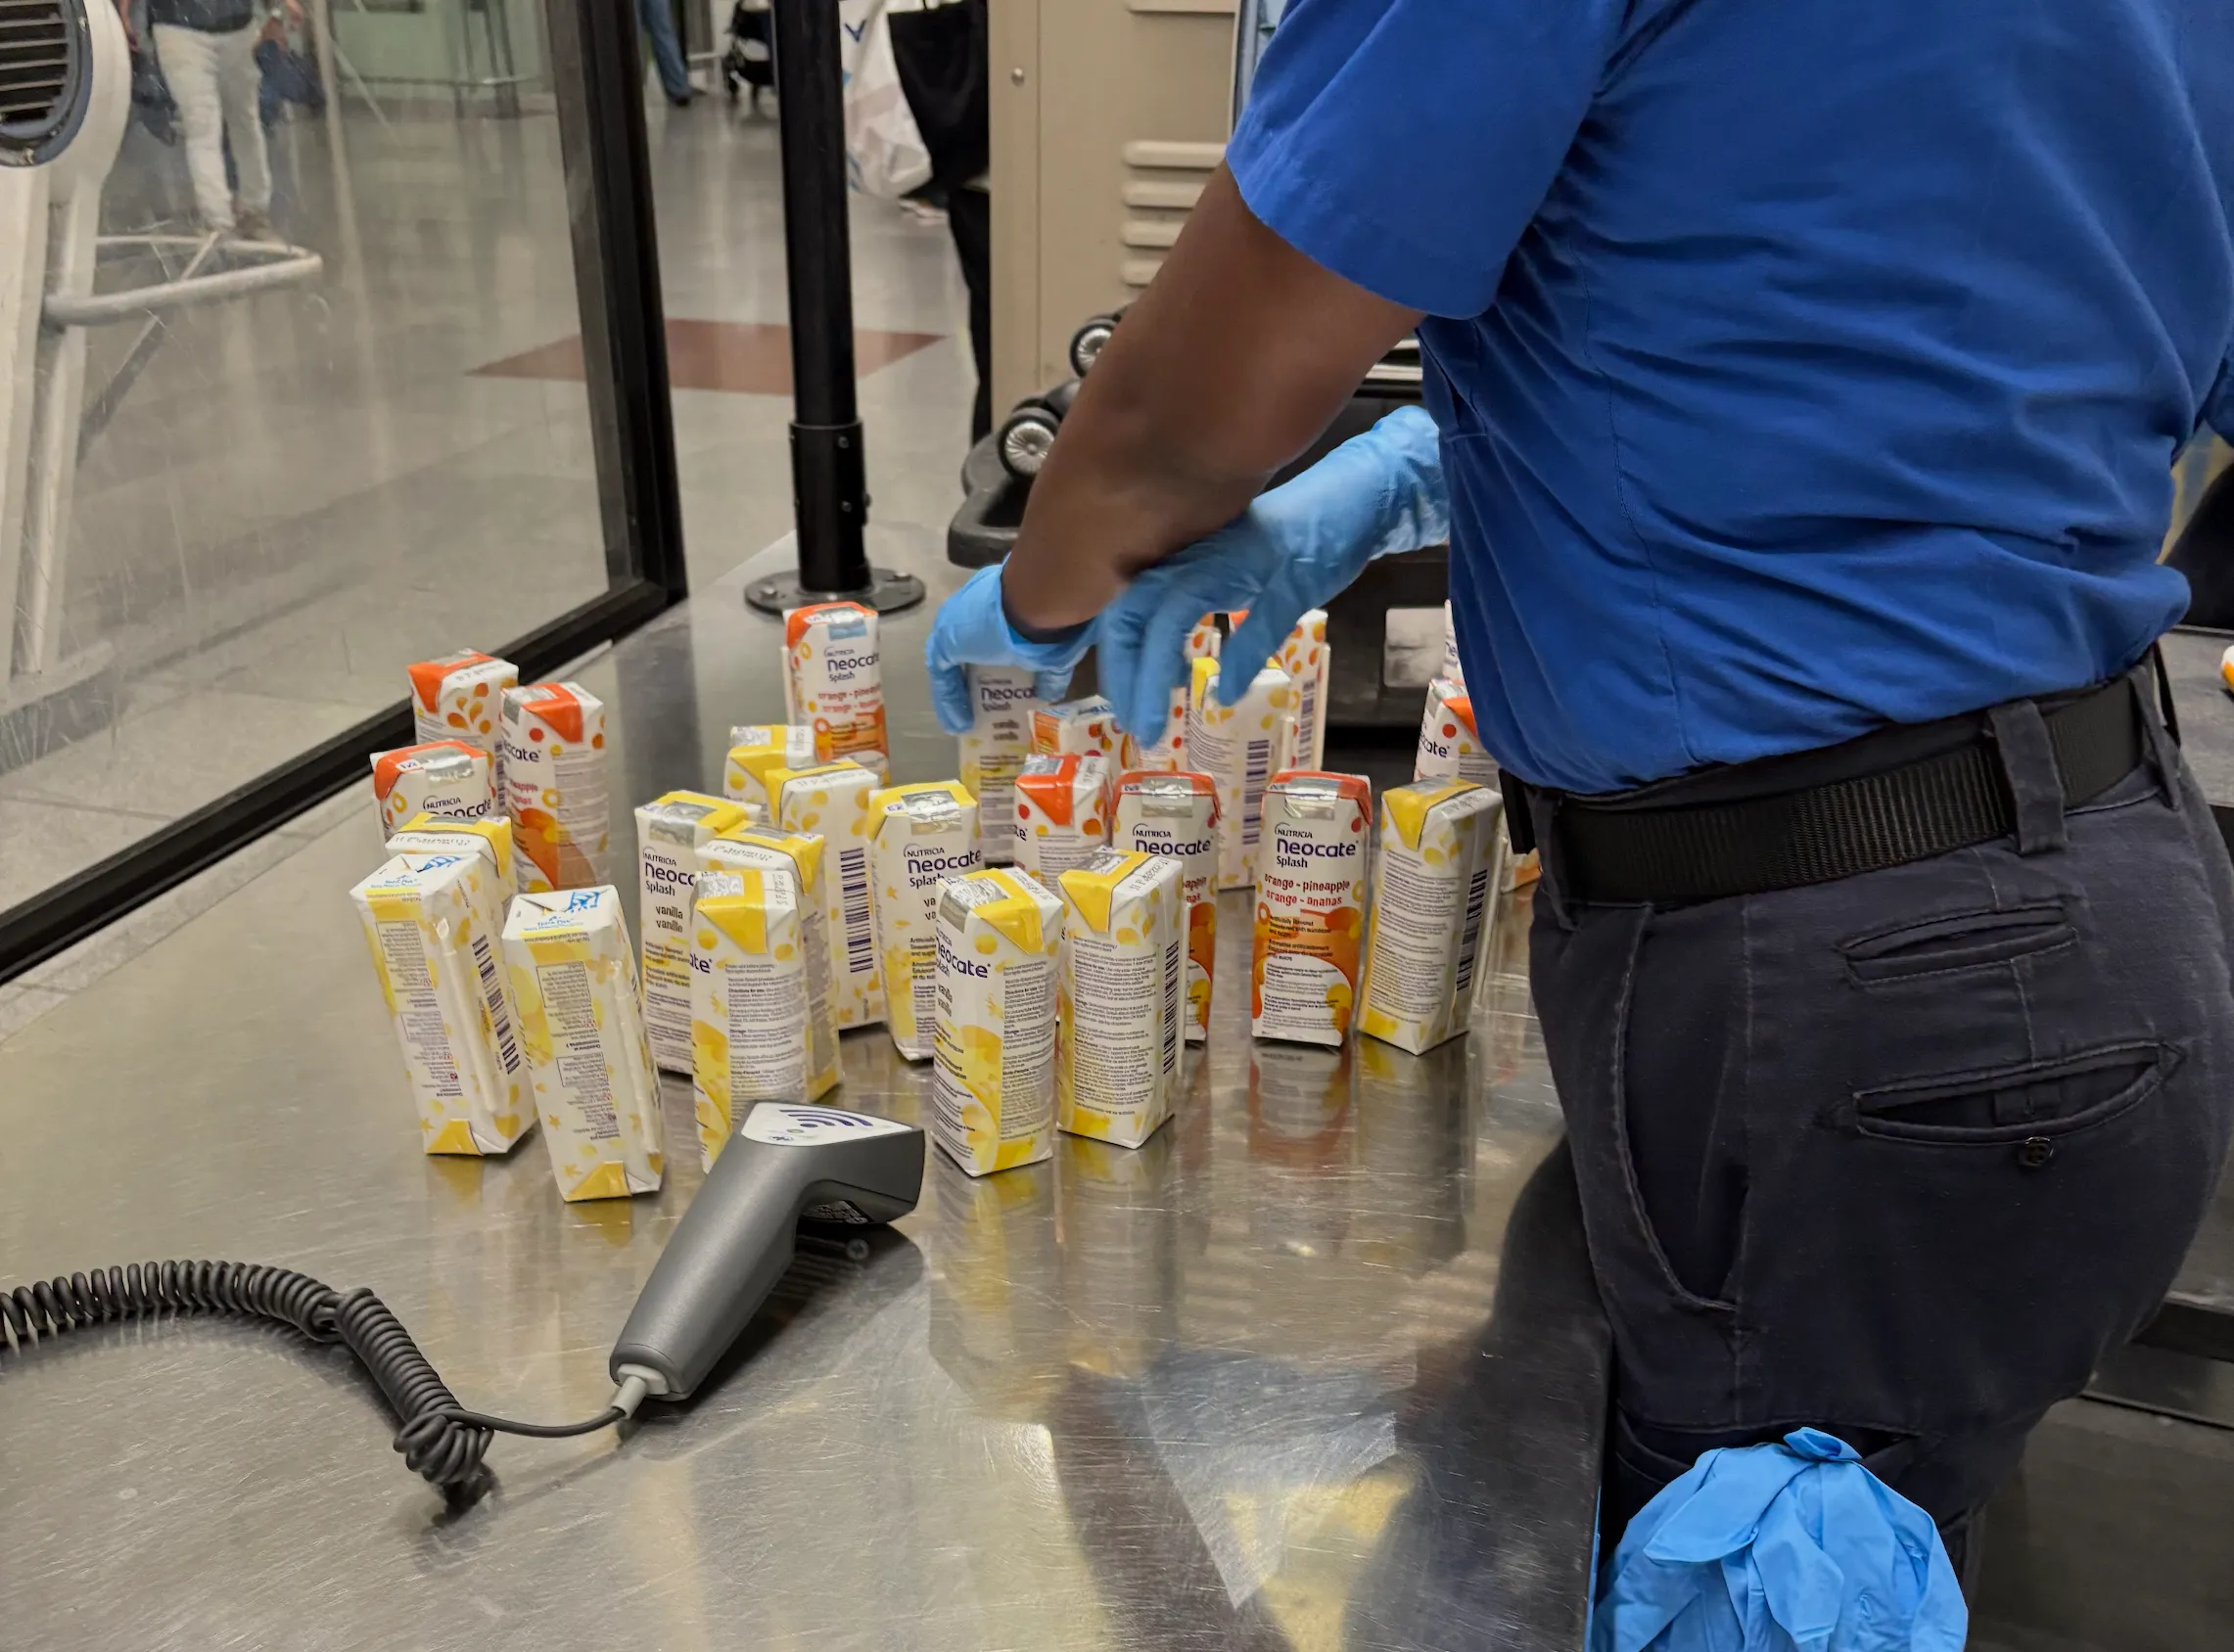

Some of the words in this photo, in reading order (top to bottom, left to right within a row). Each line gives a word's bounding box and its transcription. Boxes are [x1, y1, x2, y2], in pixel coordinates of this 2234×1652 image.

[427, 797, 461, 809] NUTRICIA
[1277, 829, 1313, 839] NUTRICIA
[908, 848, 945, 857] NUTRICIA
[1136, 839, 1211, 855] neocate
[1277, 838, 1356, 857] neocate
[644, 852, 676, 866] NUTRICIA
[908, 849, 982, 873] neocate
[1277, 855, 1308, 868] Splash
[646, 881, 675, 896] Splash
[1303, 881, 1350, 894] pineapple
[1307, 896, 1342, 907] ananas
[656, 906, 683, 919] vanilla
